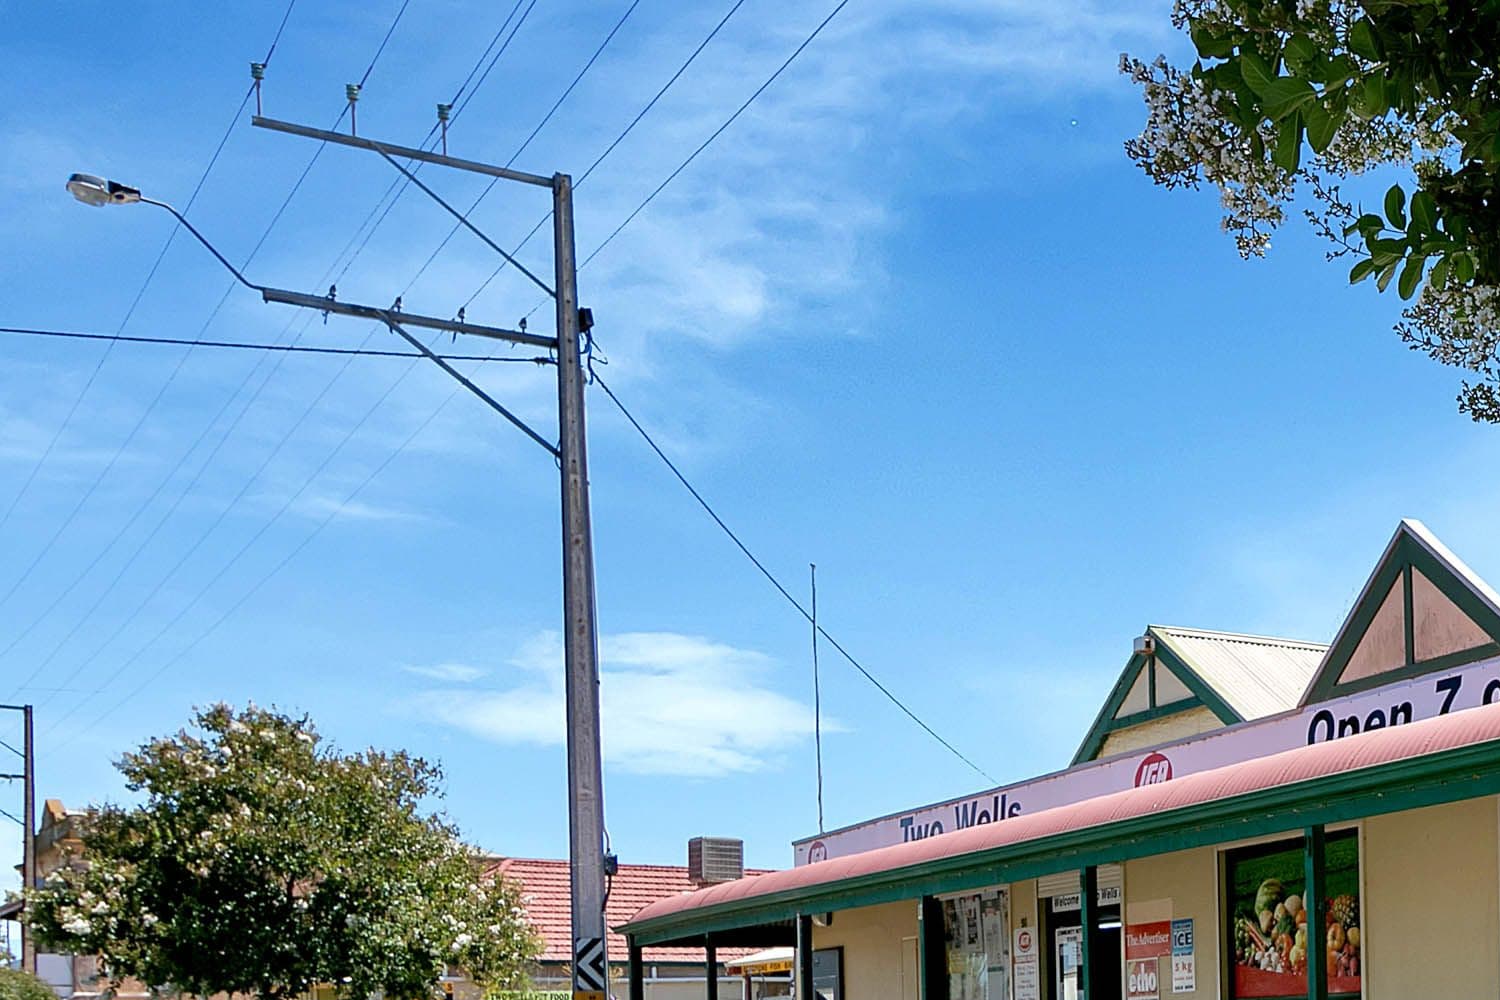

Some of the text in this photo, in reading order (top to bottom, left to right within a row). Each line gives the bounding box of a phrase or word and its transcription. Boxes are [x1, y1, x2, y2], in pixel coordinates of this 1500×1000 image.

[1307, 700, 1414, 746] Open
[1435, 674, 1463, 716] 7
[899, 793, 1023, 843] Two Wells
[1054, 895, 1080, 908] Welcome
[1127, 931, 1169, 947] The Advertiser
[1128, 962, 1157, 993] echo
[549, 992, 570, 1000] FOOD
